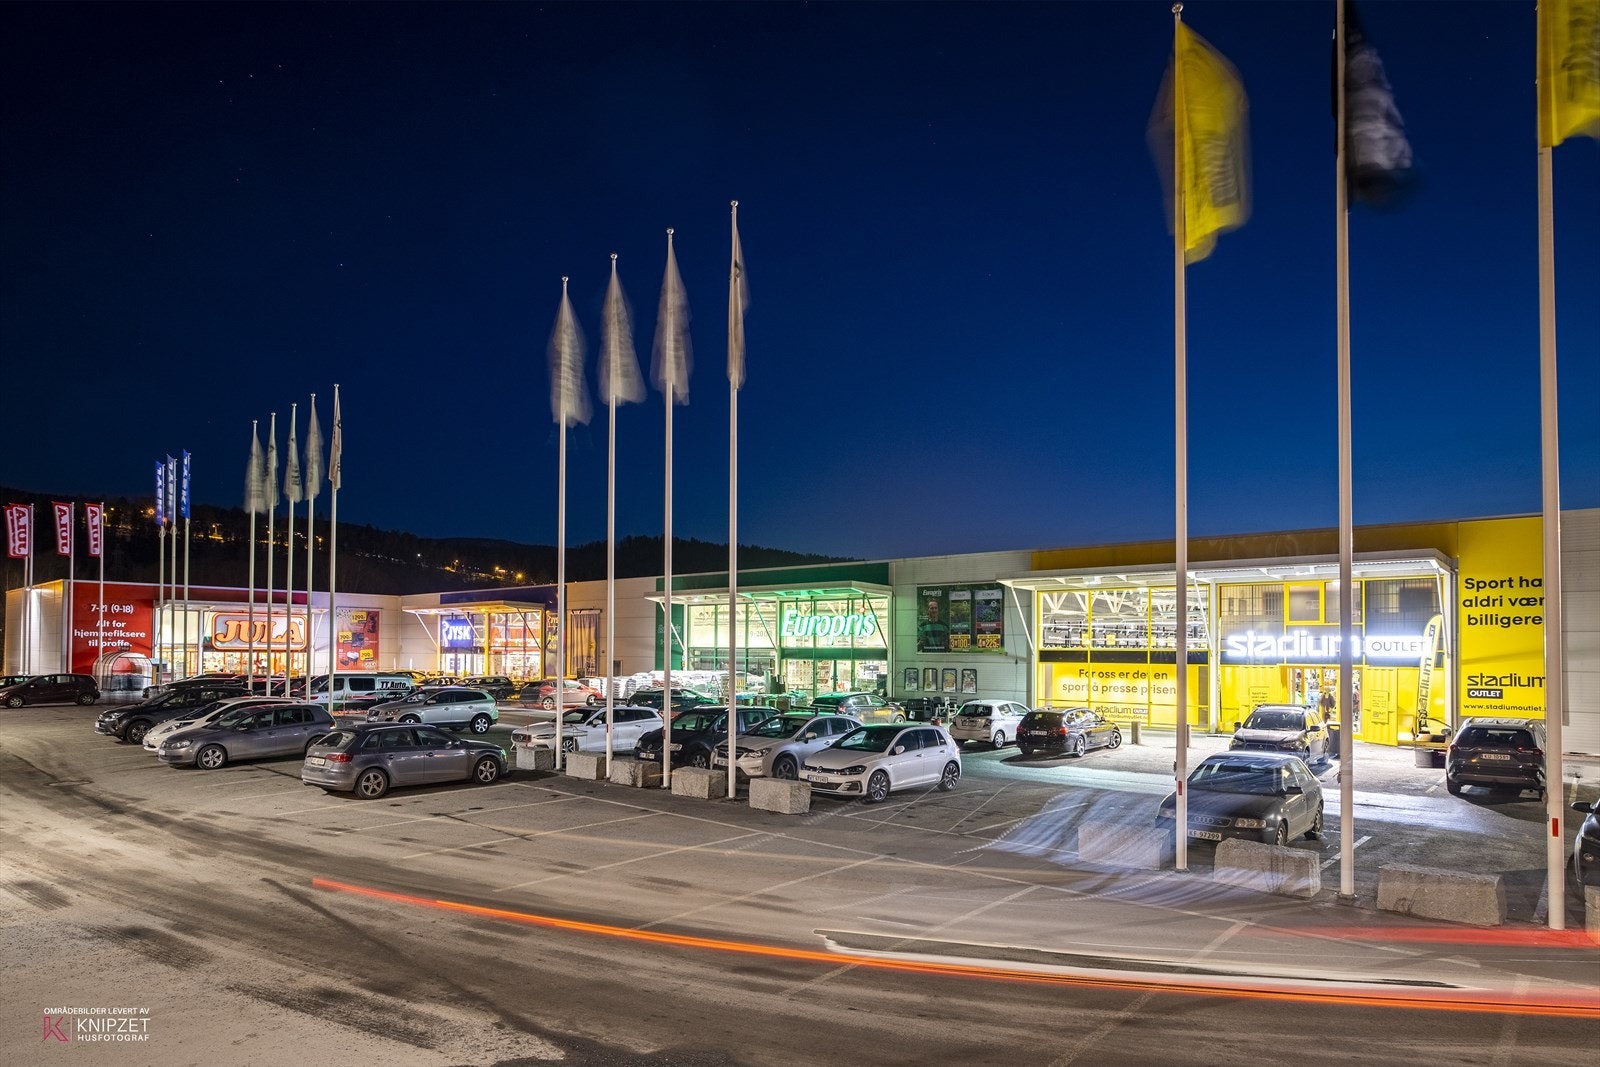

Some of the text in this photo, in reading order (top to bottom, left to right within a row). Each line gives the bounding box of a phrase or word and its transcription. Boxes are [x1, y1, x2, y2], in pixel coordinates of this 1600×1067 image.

[1464, 576, 1543, 592] Sport ha
[1462, 595, 1545, 608] aldri vær
[110, 603, 134, 614] (9-18)
[112, 620, 126, 628] for
[781, 609, 877, 645] Europris
[1467, 614, 1543, 628] billigere
[215, 620, 304, 643] JULA
[448, 625, 471, 640] JYSK
[101, 640, 133, 648] proffe.
[1226, 630, 1426, 657] stadium OUTLET
[1118, 671, 1130, 679] er
[1132, 670, 1149, 679] de
[1154, 672, 1168, 680] en
[1467, 673, 1546, 687] stadium
[390, 681, 407, 689] Auto
[1101, 684, 1138, 694] presse
[1141, 686, 1176, 695] pisen
